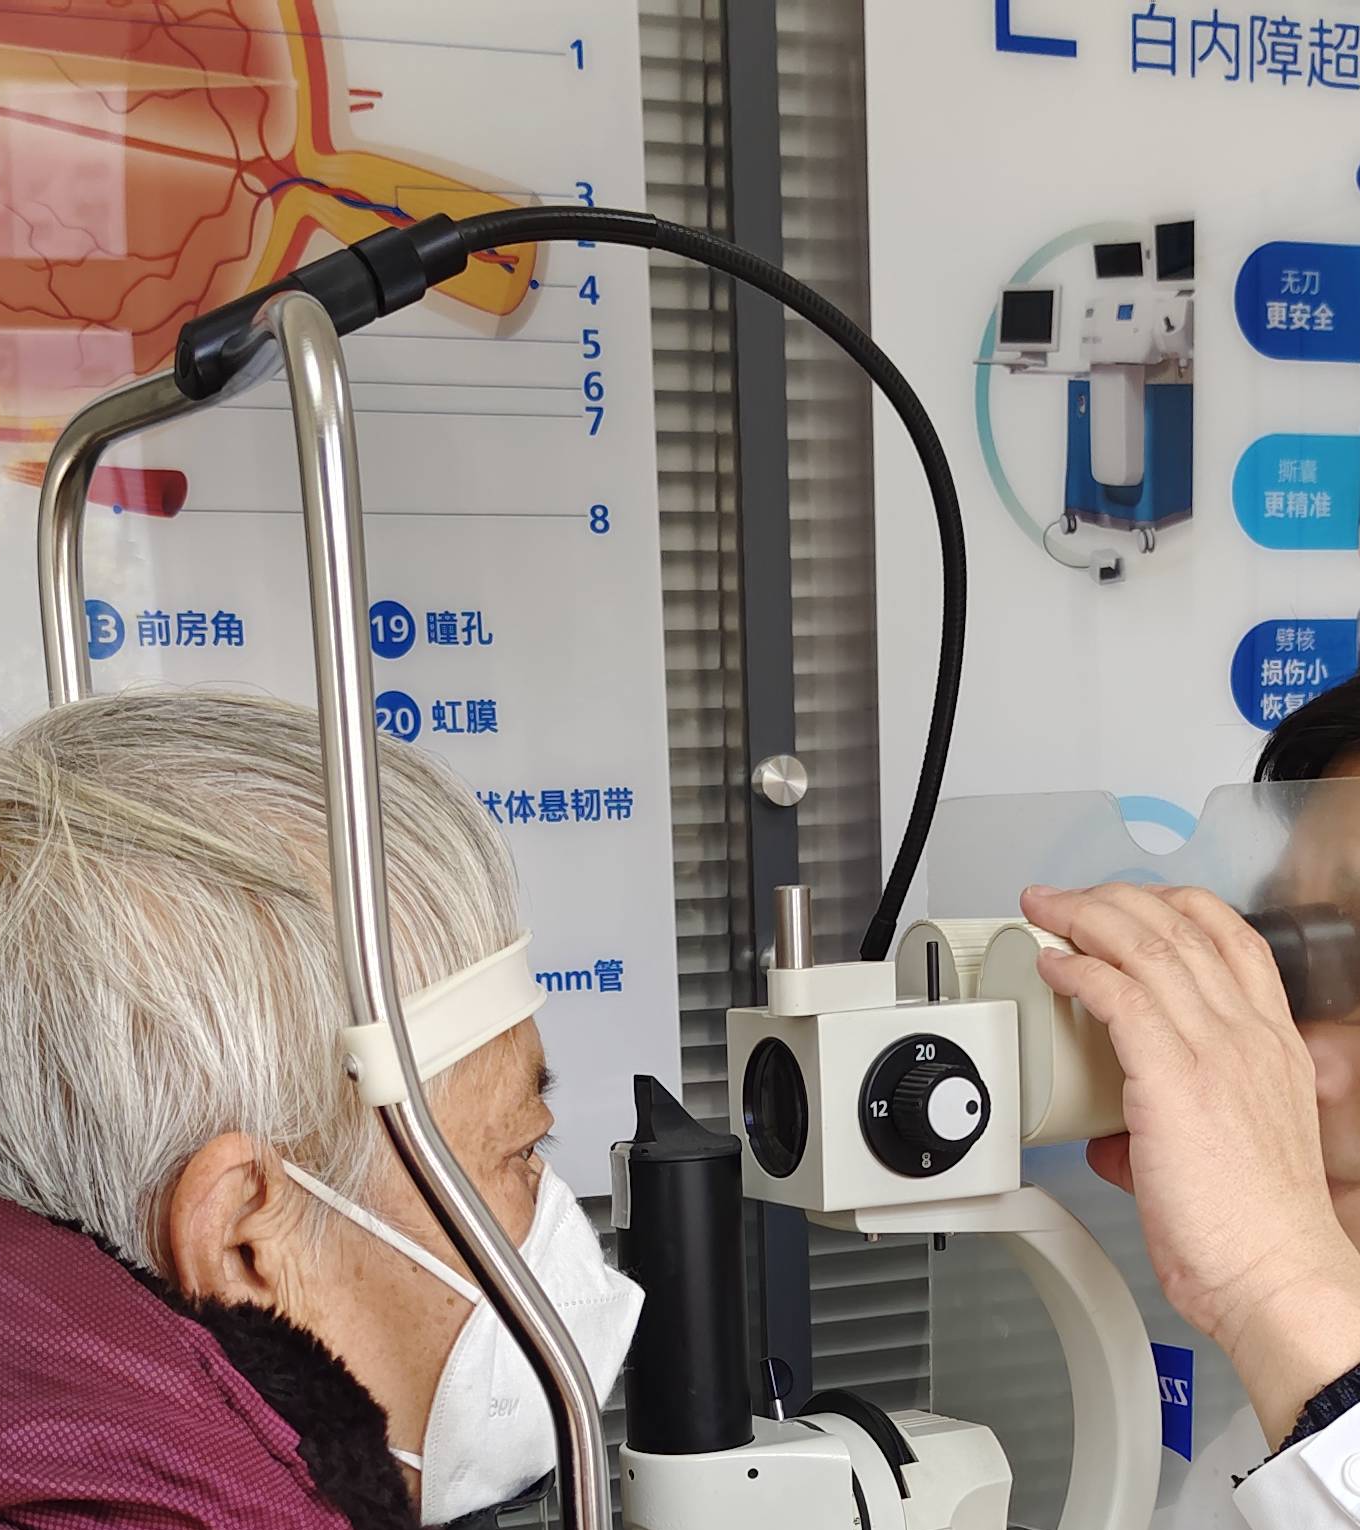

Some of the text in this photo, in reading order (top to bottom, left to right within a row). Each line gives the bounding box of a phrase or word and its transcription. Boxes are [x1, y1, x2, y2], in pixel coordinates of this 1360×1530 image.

[570, 40, 585, 69] 1
[576, 182, 594, 207] 3
[577, 276, 601, 305] 4
[1280, 269, 1321, 296] 无刀
[1265, 301, 1335, 331] 更安全
[583, 330, 601, 360] 5
[583, 372, 604, 402] 6
[585, 407, 605, 436] 7
[1264, 490, 1332, 519] 更精准
[588, 505, 610, 535] 8
[136, 609, 246, 647] 前房角
[425, 609, 494, 646] 瞳孔
[1275, 626, 1317, 653] 劈核
[1260, 658, 1329, 687] 损伤小
[431, 699, 500, 735] 虹膜
[1260, 691, 1320, 720] 恢复
[915, 1043, 936, 1062] 20
[870, 1100, 888, 1118] 12
[921, 1151, 932, 1169] 8
